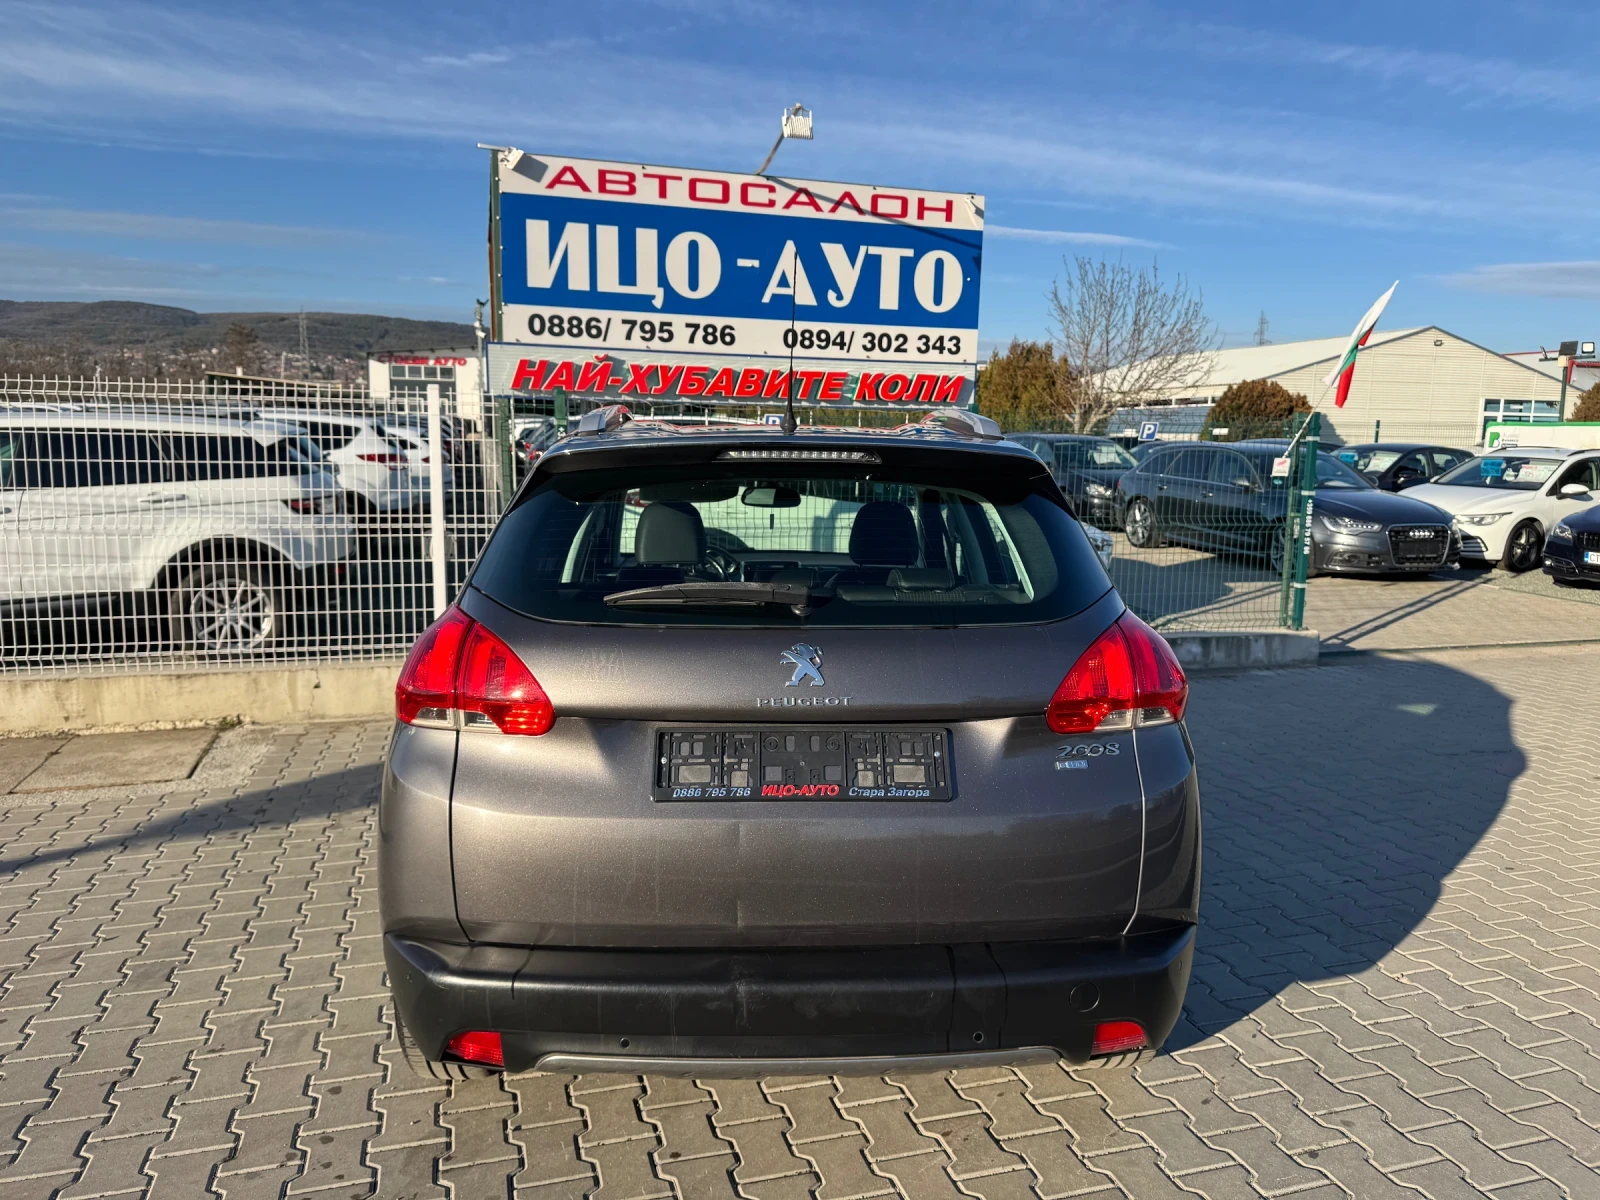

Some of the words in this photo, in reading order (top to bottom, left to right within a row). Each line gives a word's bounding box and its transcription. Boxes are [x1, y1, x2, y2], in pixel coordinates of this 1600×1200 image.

[545, 165, 954, 223] АВТОСАЛОН
[528, 313, 612, 342] 0886/
[621, 319, 674, 343] 795
[685, 322, 736, 346] 786
[783, 328, 855, 353] 0894/
[861, 332, 908, 353] 302
[916, 334, 961, 355] 343
[854, 372, 965, 403] КОЛИ
[1143, 424, 1154, 438] P
[757, 696, 853, 707] PEUGEOT
[1056, 742, 1120, 759] 2008
[673, 788, 702, 797] 0886
[705, 788, 727, 797] 795
[730, 787, 751, 797] 786
[761, 784, 840, 797] ИЦО-АУТО
[848, 787, 885, 797] Стара
[888, 787, 930, 797] Загора
